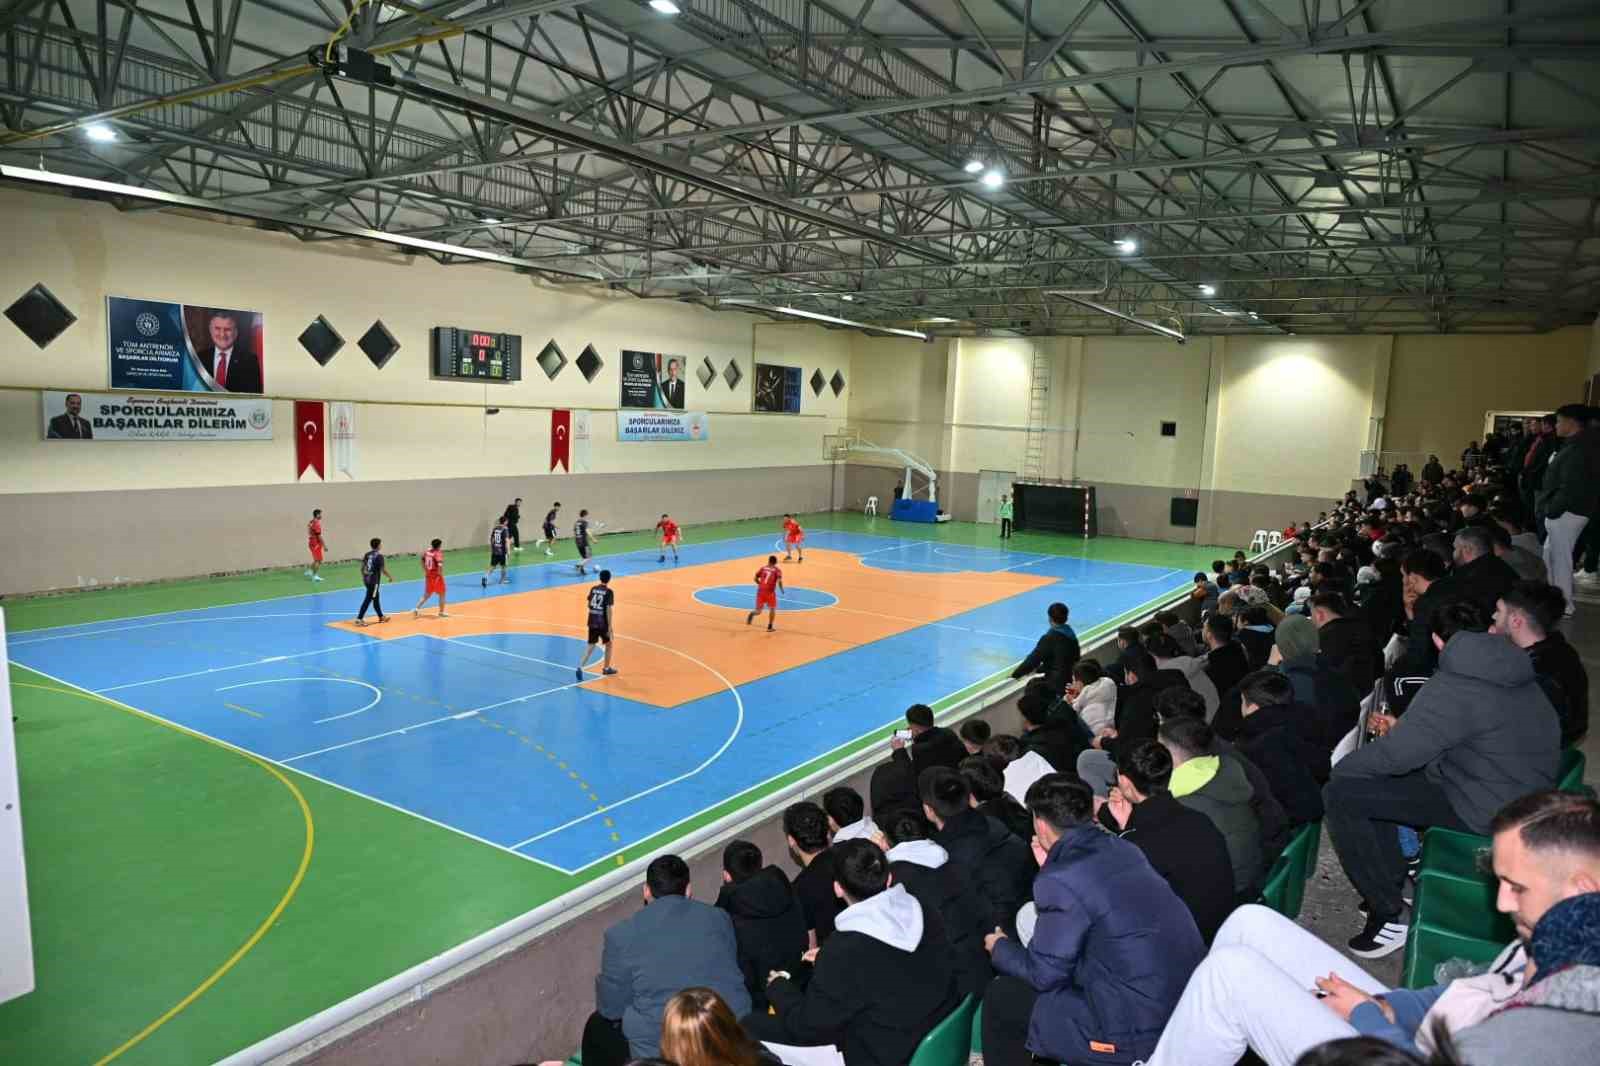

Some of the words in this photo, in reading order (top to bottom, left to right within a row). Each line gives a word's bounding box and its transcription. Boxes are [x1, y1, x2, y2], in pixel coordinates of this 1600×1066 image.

[125, 348, 180, 357] SPORCULARIMIZA
[100, 405, 236, 417] SPORCULARIMIZA
[93, 417, 184, 430] BAŞARILAR
[188, 417, 247, 430] DİLERİM
[628, 416, 681, 426] SPORCULARIMIZA
[625, 425, 660, 434] BAŞARILAR
[590, 593, 604, 610] 42
